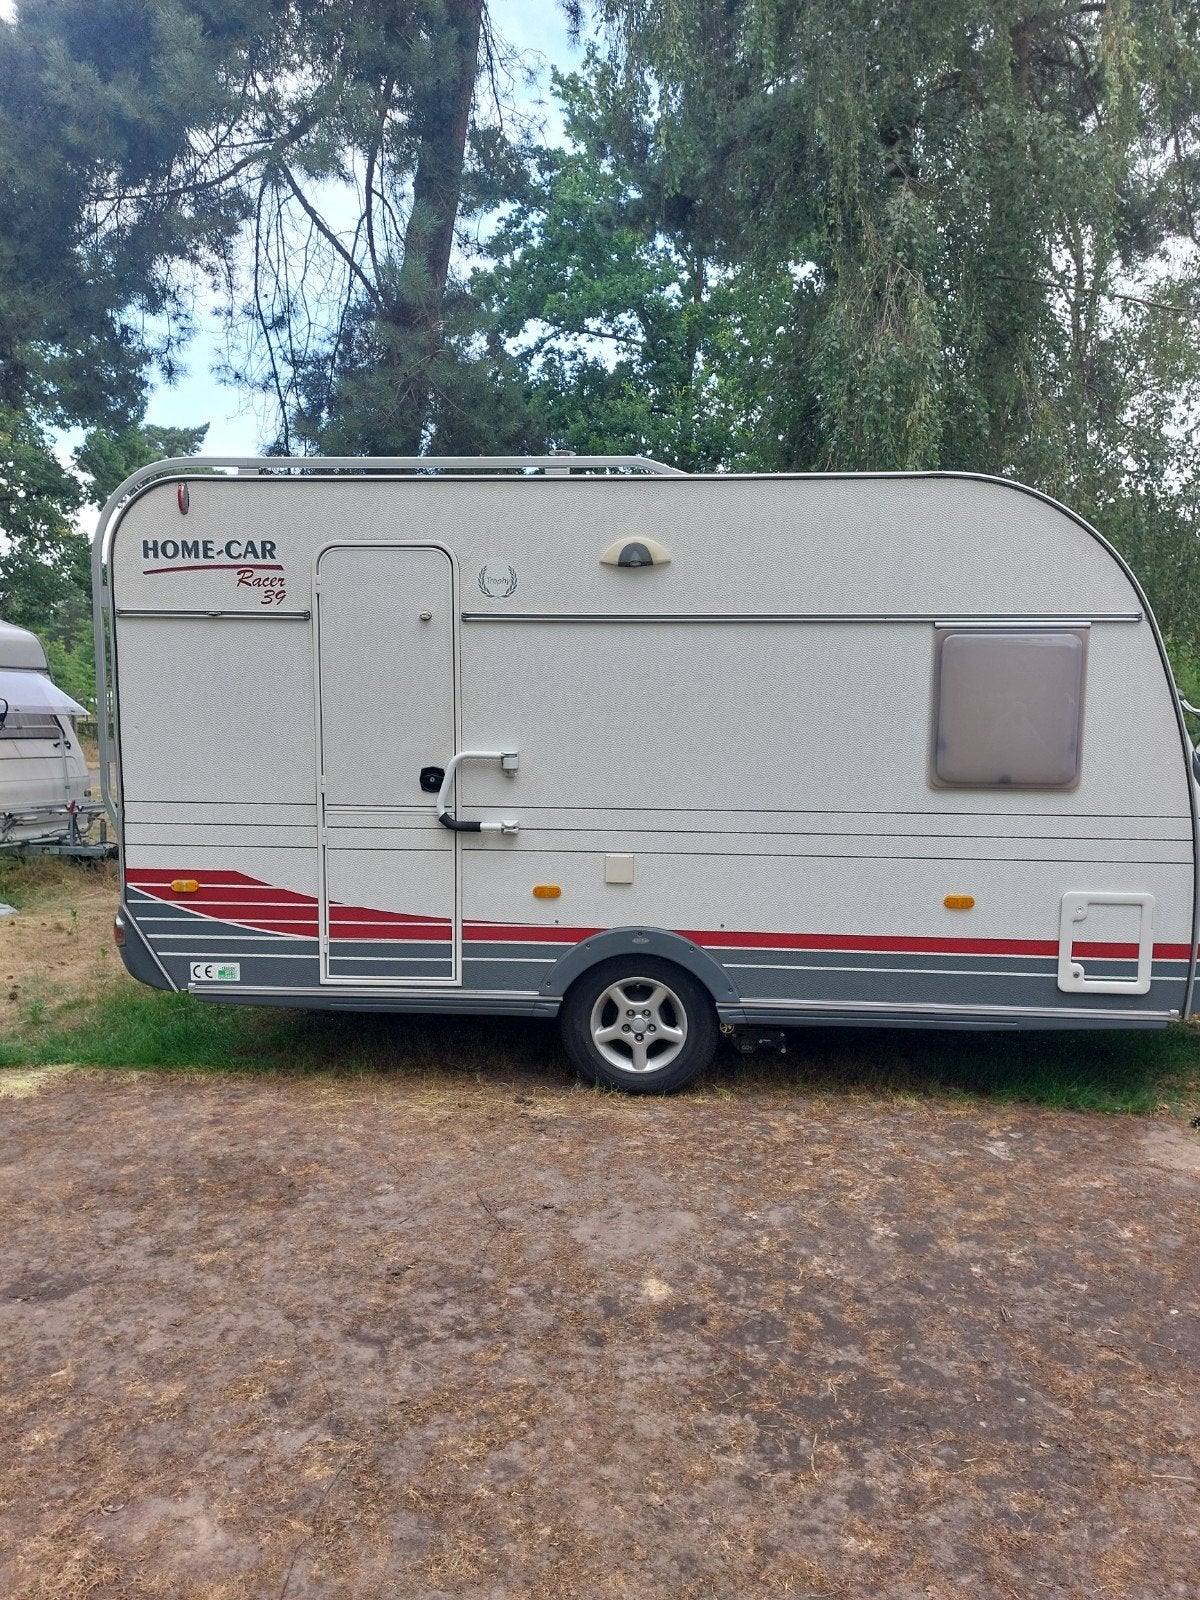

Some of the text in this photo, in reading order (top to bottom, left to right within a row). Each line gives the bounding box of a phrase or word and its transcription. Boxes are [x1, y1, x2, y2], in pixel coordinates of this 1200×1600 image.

[142, 539, 277, 560] HOME-CAR
[236, 569, 286, 588] Racer
[486, 576, 511, 587] Trophy
[260, 589, 287, 606] 39
[192, 964, 213, 979] CE
